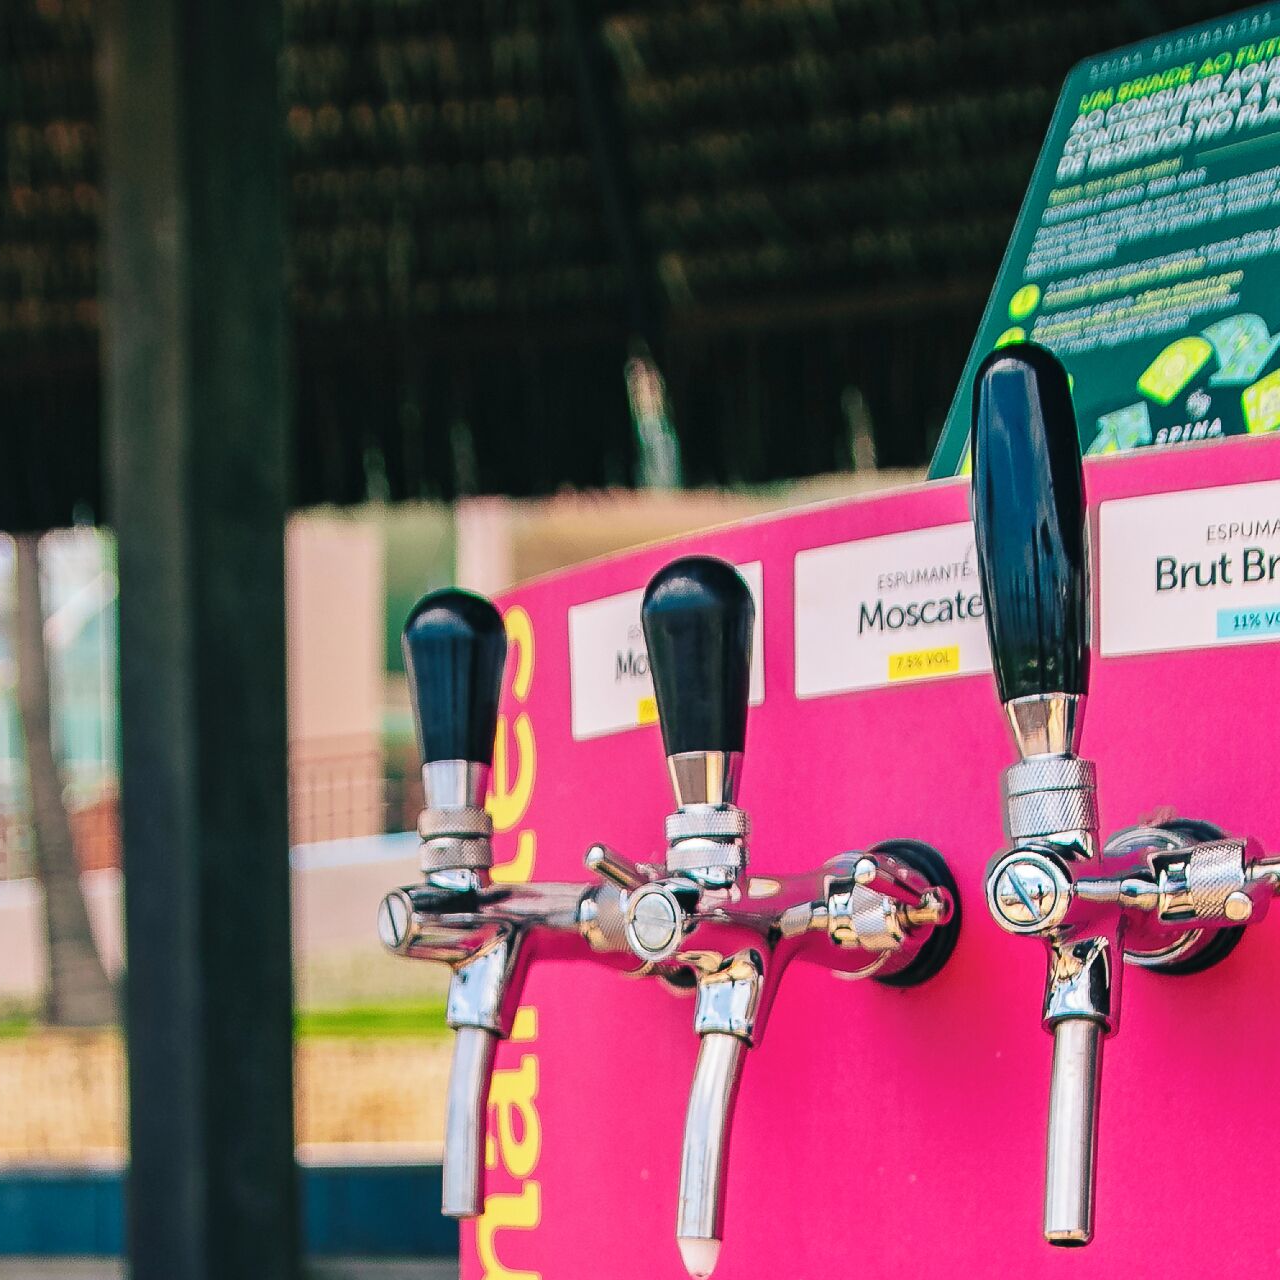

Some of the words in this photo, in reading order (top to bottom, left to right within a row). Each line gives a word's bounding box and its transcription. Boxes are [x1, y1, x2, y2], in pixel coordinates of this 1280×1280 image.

[1197, 52, 1233, 83] AO
[1154, 417, 1223, 445] SPINA
[877, 561, 971, 590] ESPUMANTE
[1155, 551, 1233, 593] Brut
[858, 589, 985, 635] Moscate
[1232, 612, 1262, 630] 11%
[926, 649, 951, 665] VOL
